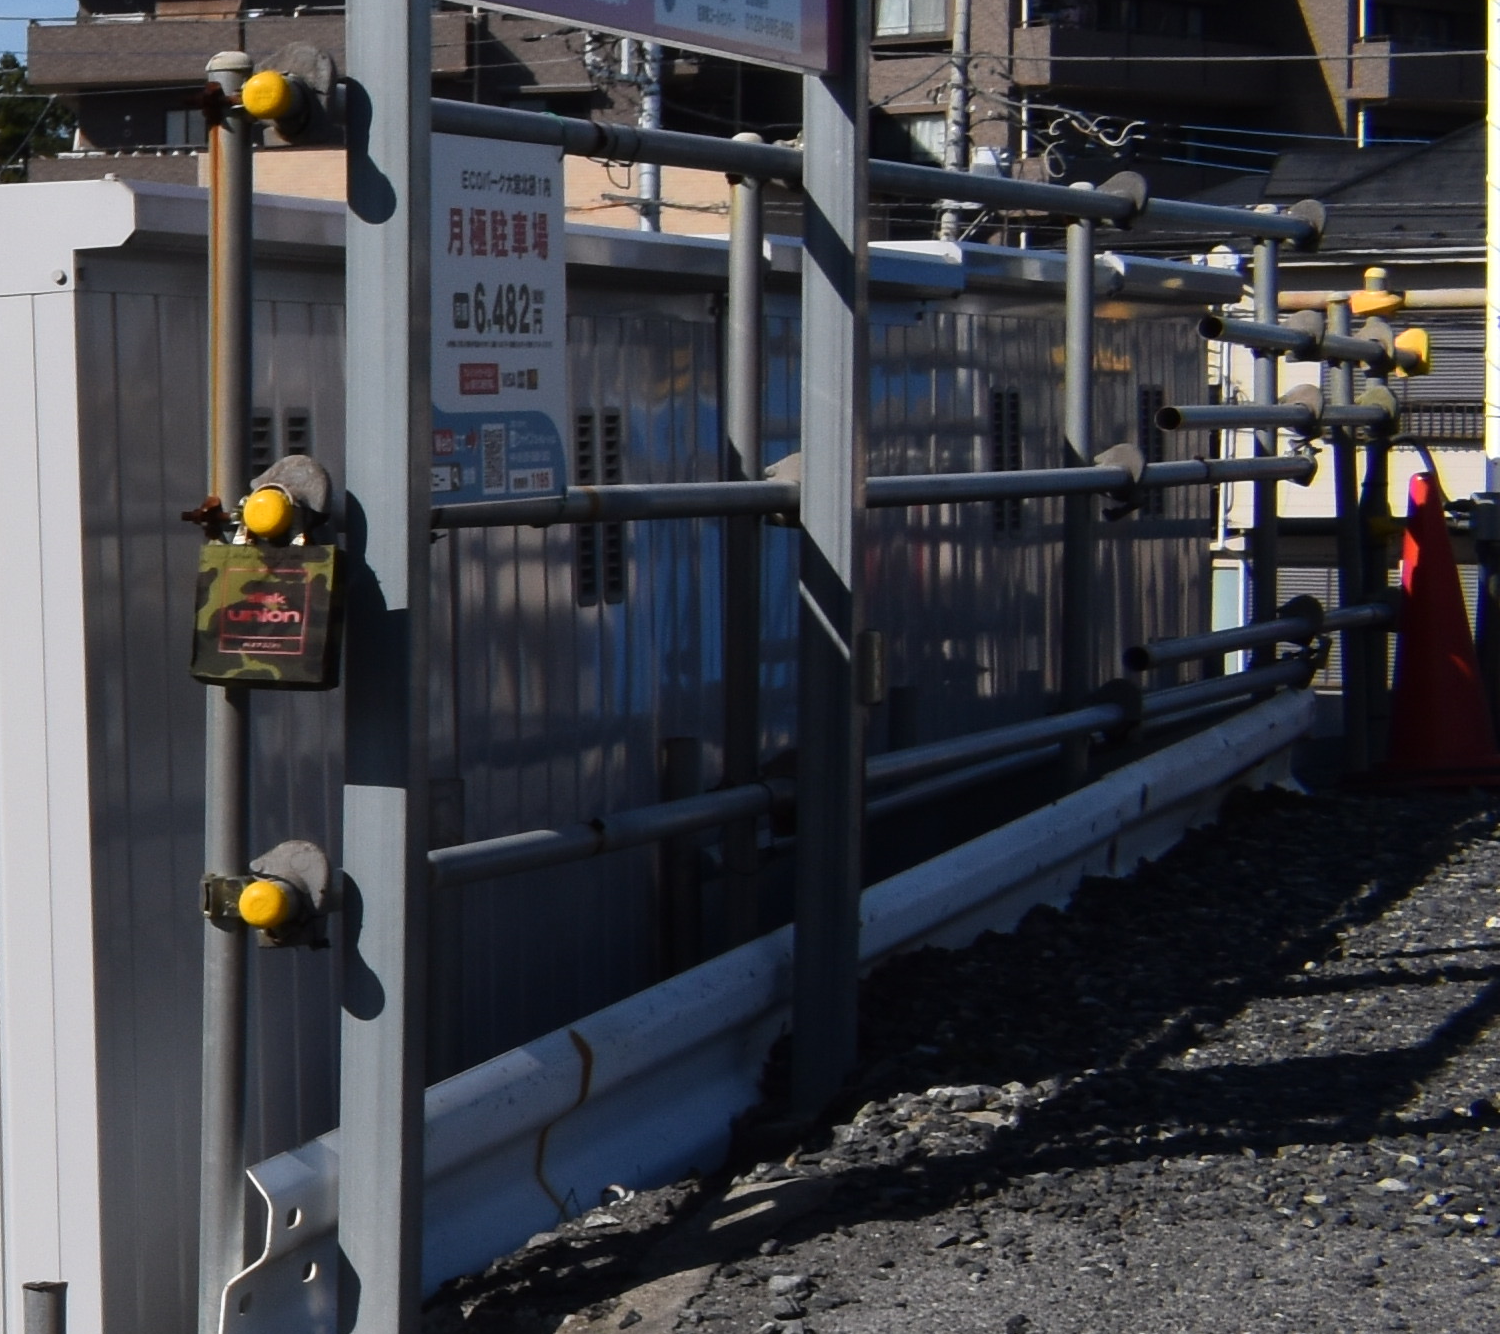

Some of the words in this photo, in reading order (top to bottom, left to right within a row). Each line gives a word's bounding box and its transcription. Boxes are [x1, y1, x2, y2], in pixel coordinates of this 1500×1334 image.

[448, 208, 548, 260] 月極駐車場
[228, 607, 300, 623] union
